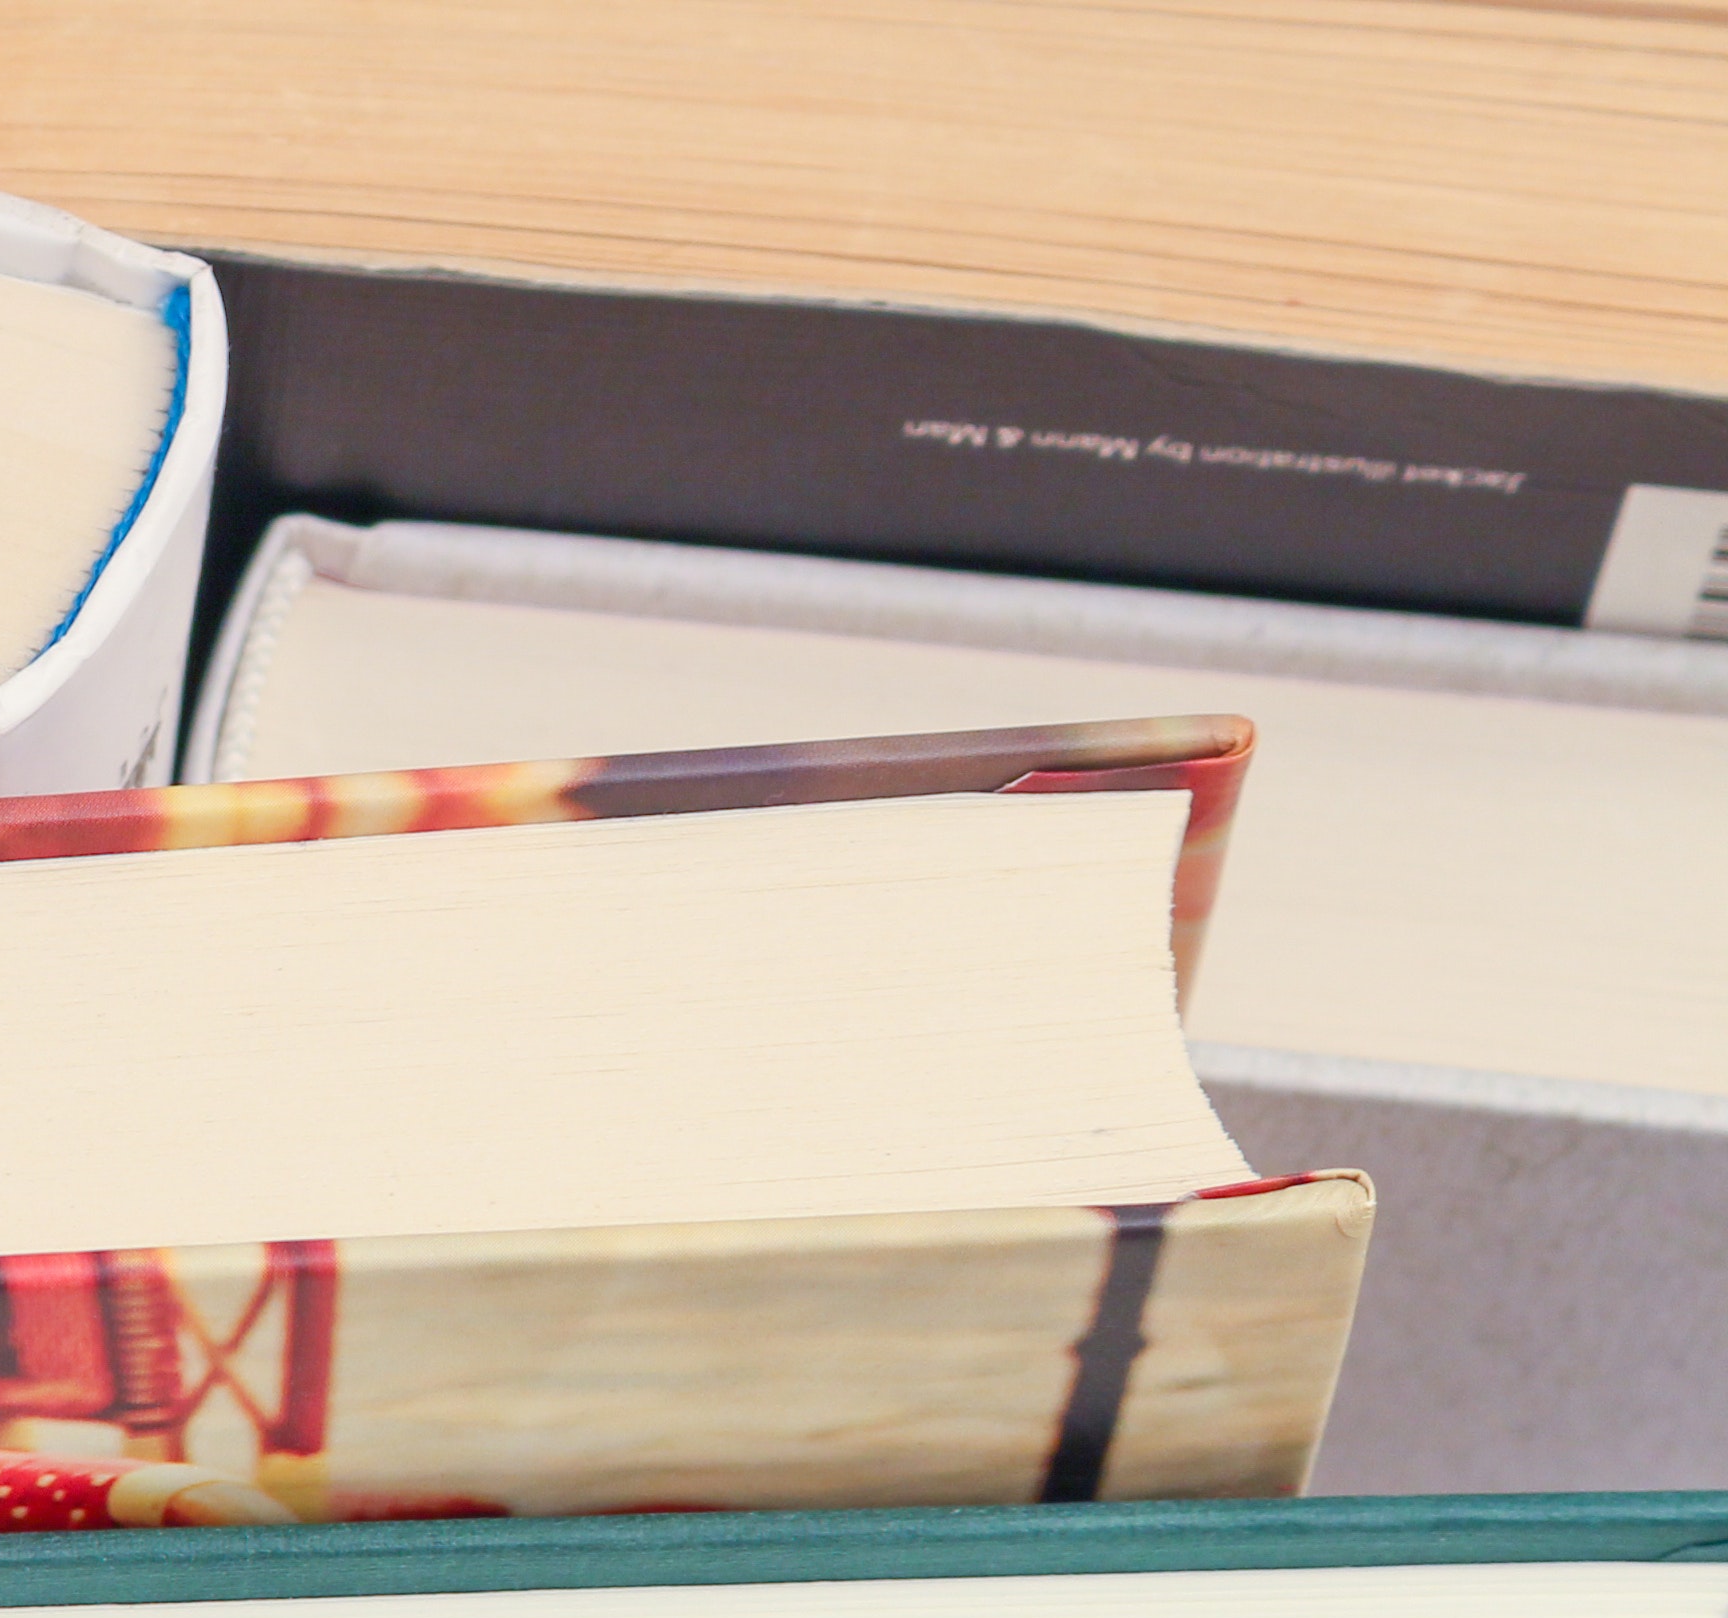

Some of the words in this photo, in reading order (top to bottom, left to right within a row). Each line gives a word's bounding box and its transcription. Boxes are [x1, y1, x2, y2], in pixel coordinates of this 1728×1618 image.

[903, 420, 988, 446] Man
[997, 426, 1024, 448] &
[1030, 431, 1139, 460] Mann
[1147, 434, 1193, 463] by
[1199, 446, 1396, 480] illustration
[1403, 464, 1526, 494] Jacket
